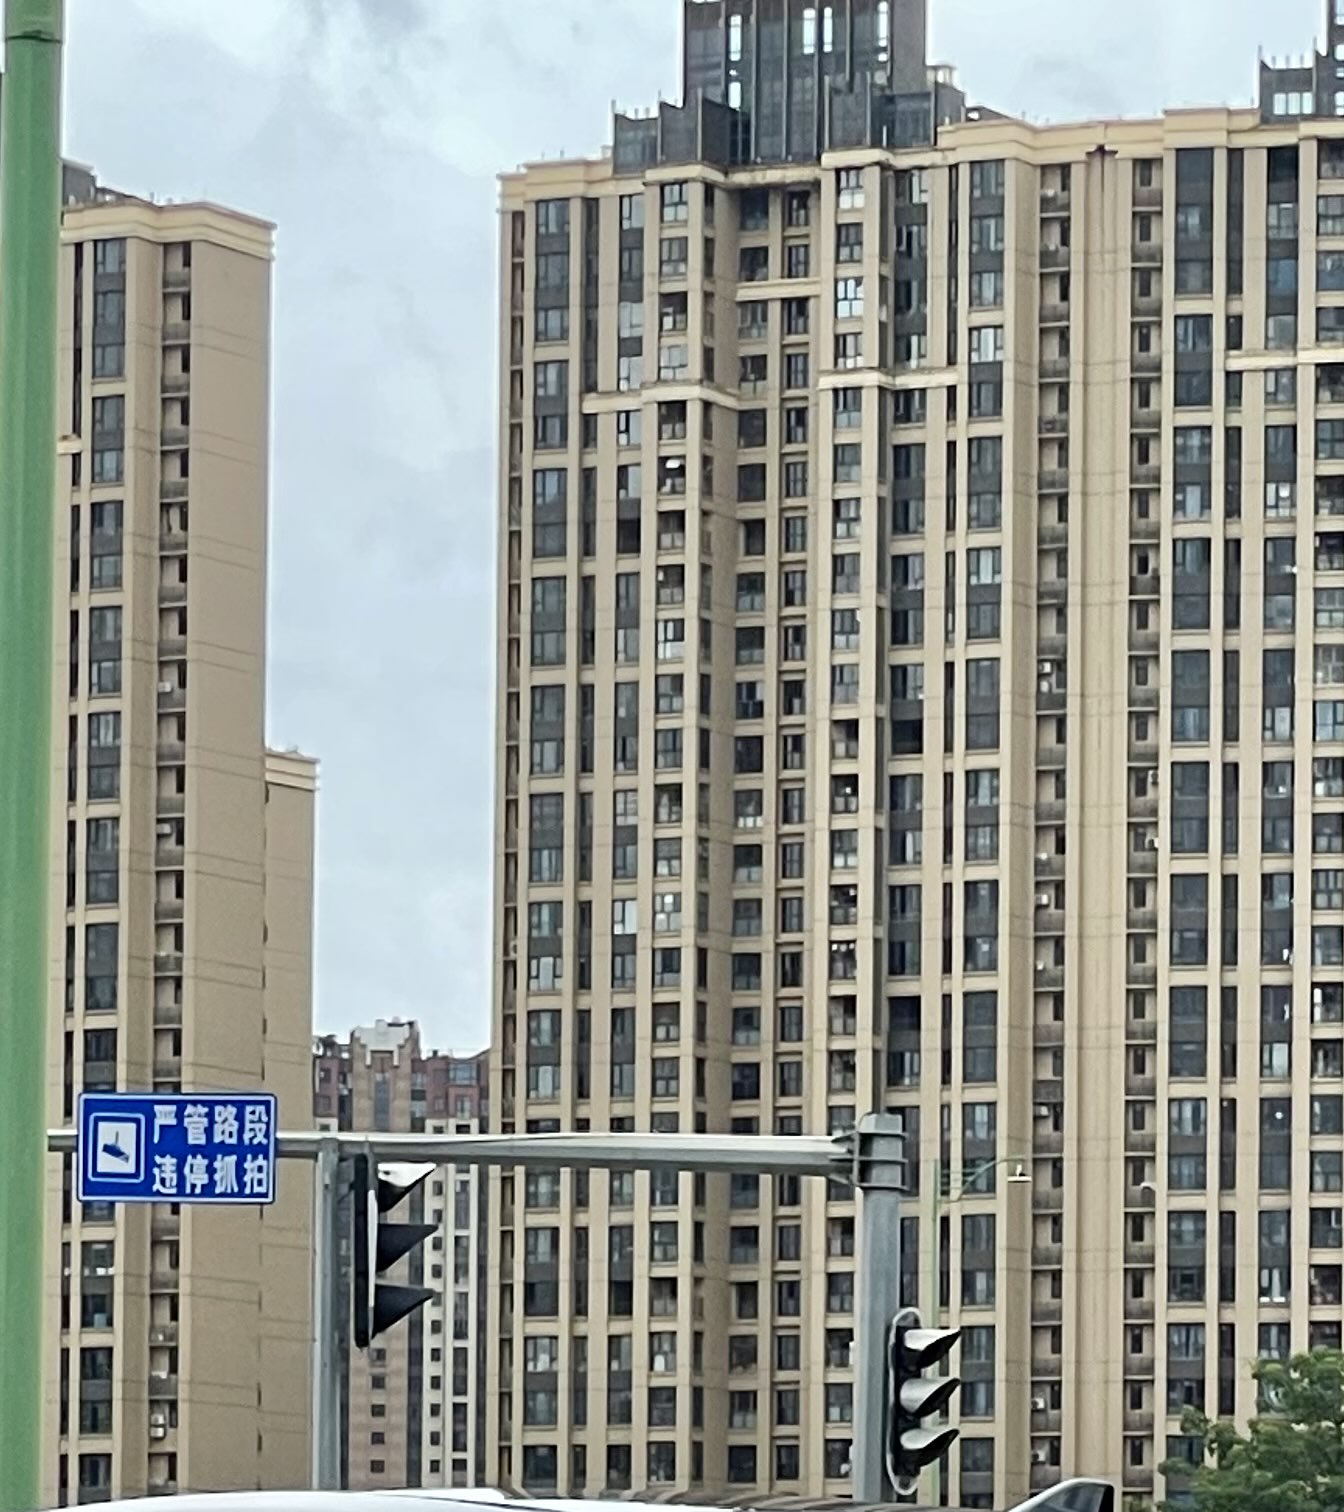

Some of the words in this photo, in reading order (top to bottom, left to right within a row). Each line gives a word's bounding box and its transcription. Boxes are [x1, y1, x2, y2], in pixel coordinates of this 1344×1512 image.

[152, 1104, 269, 1145] 严管路段
[152, 1154, 268, 1195] 违停抓拍
